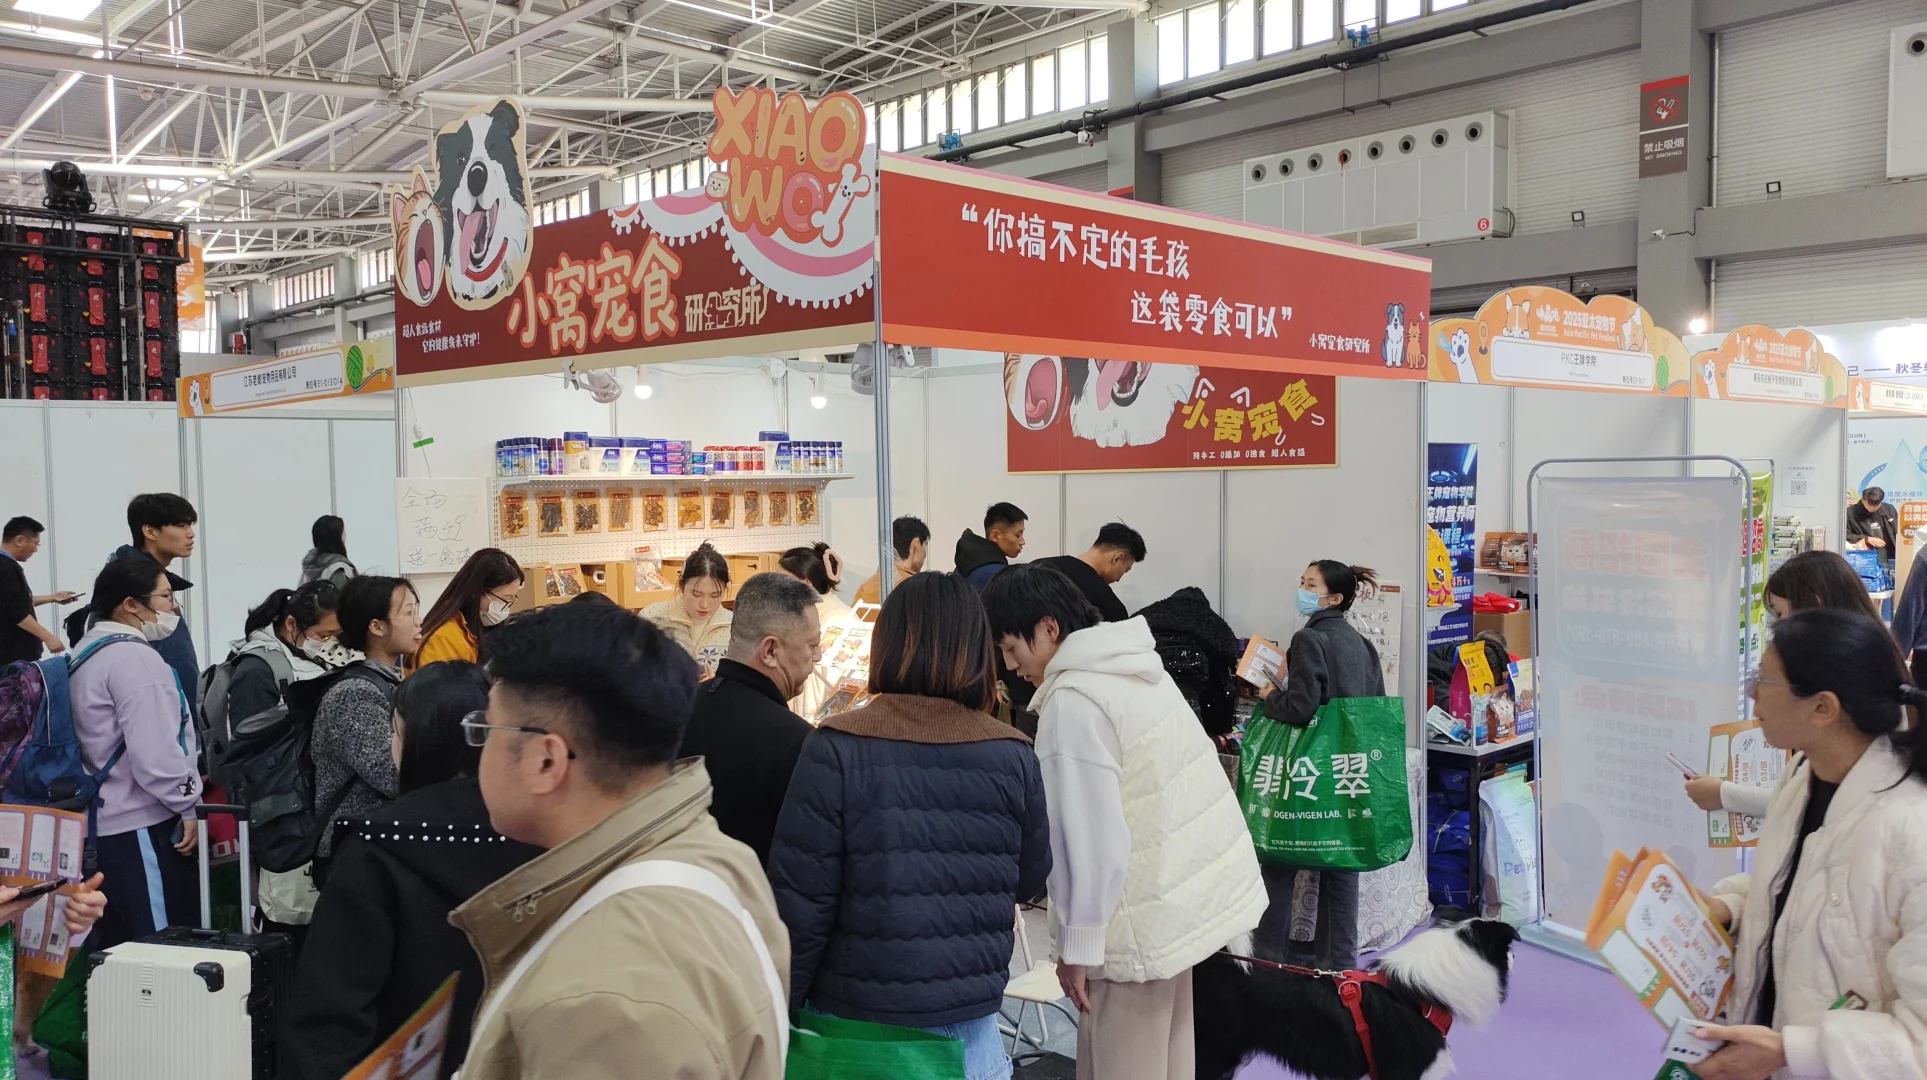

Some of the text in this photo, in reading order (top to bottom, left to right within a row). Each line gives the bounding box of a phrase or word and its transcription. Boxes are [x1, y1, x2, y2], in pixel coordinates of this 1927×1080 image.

[711, 88, 862, 172] XIAO
[1643, 137, 1684, 153] 禁止吸烟
[1656, 150, 1683, 159] SMOKING
[728, 157, 829, 234] WO
[1479, 218, 1488, 231] 6
[508, 236, 681, 353] 小窝宠食
[684, 284, 769, 332] 研究所
[1563, 310, 1616, 333] 2025亚太宠物节
[1309, 333, 1371, 354] 小窝宠食研究所
[1561, 353, 1597, 367] PKC王牌学院
[1896, 362, 1927, 375] 秋冬
[1181, 378, 1319, 443] 小窝宠食
[402, 486, 447, 509] 全场
[1427, 505, 1476, 523] 宠物营养师
[1324, 810, 1343, 818] LAB.
